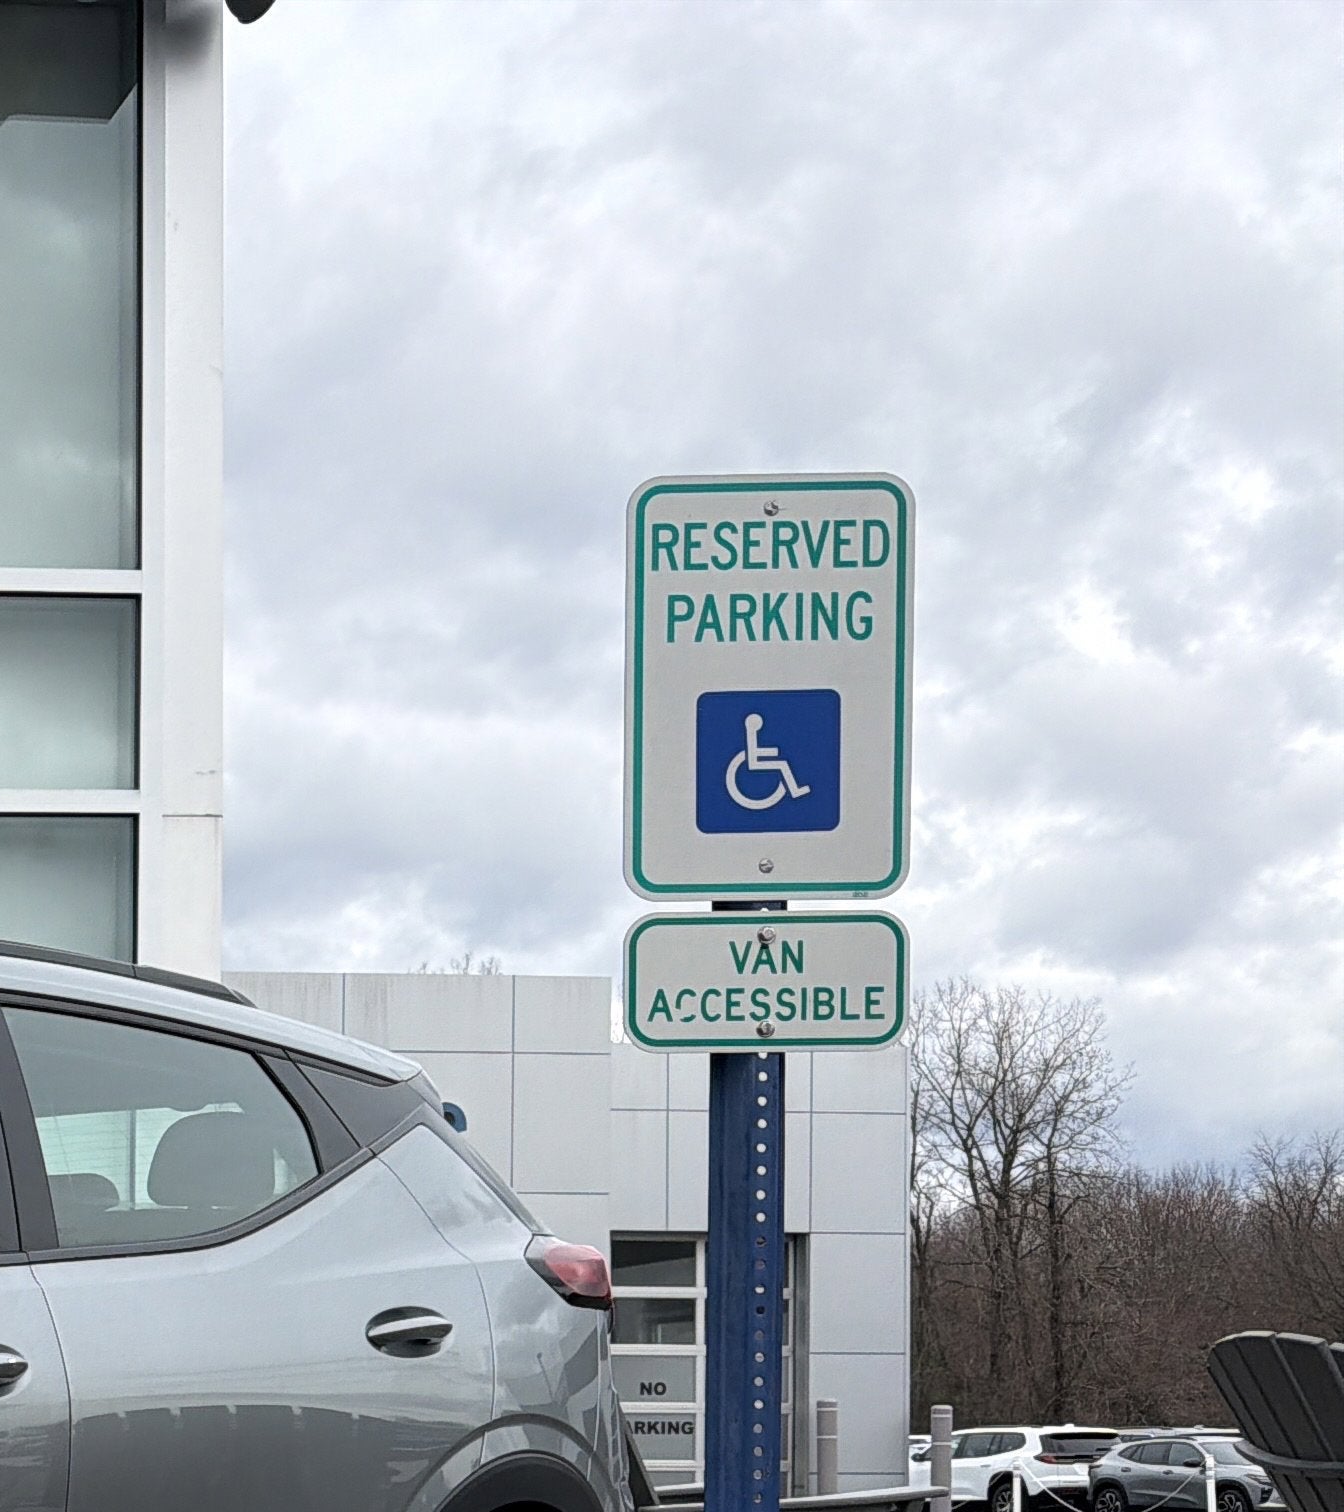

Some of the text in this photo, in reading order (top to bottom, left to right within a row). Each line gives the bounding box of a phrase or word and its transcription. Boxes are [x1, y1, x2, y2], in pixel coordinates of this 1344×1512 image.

[651, 519, 890, 571] RESERVED
[666, 591, 873, 643] PARKING
[728, 940, 804, 974] VAN
[647, 986, 885, 1022] ACCESSIBLE
[639, 1381, 667, 1396] NO
[628, 1421, 695, 1435] RKING
